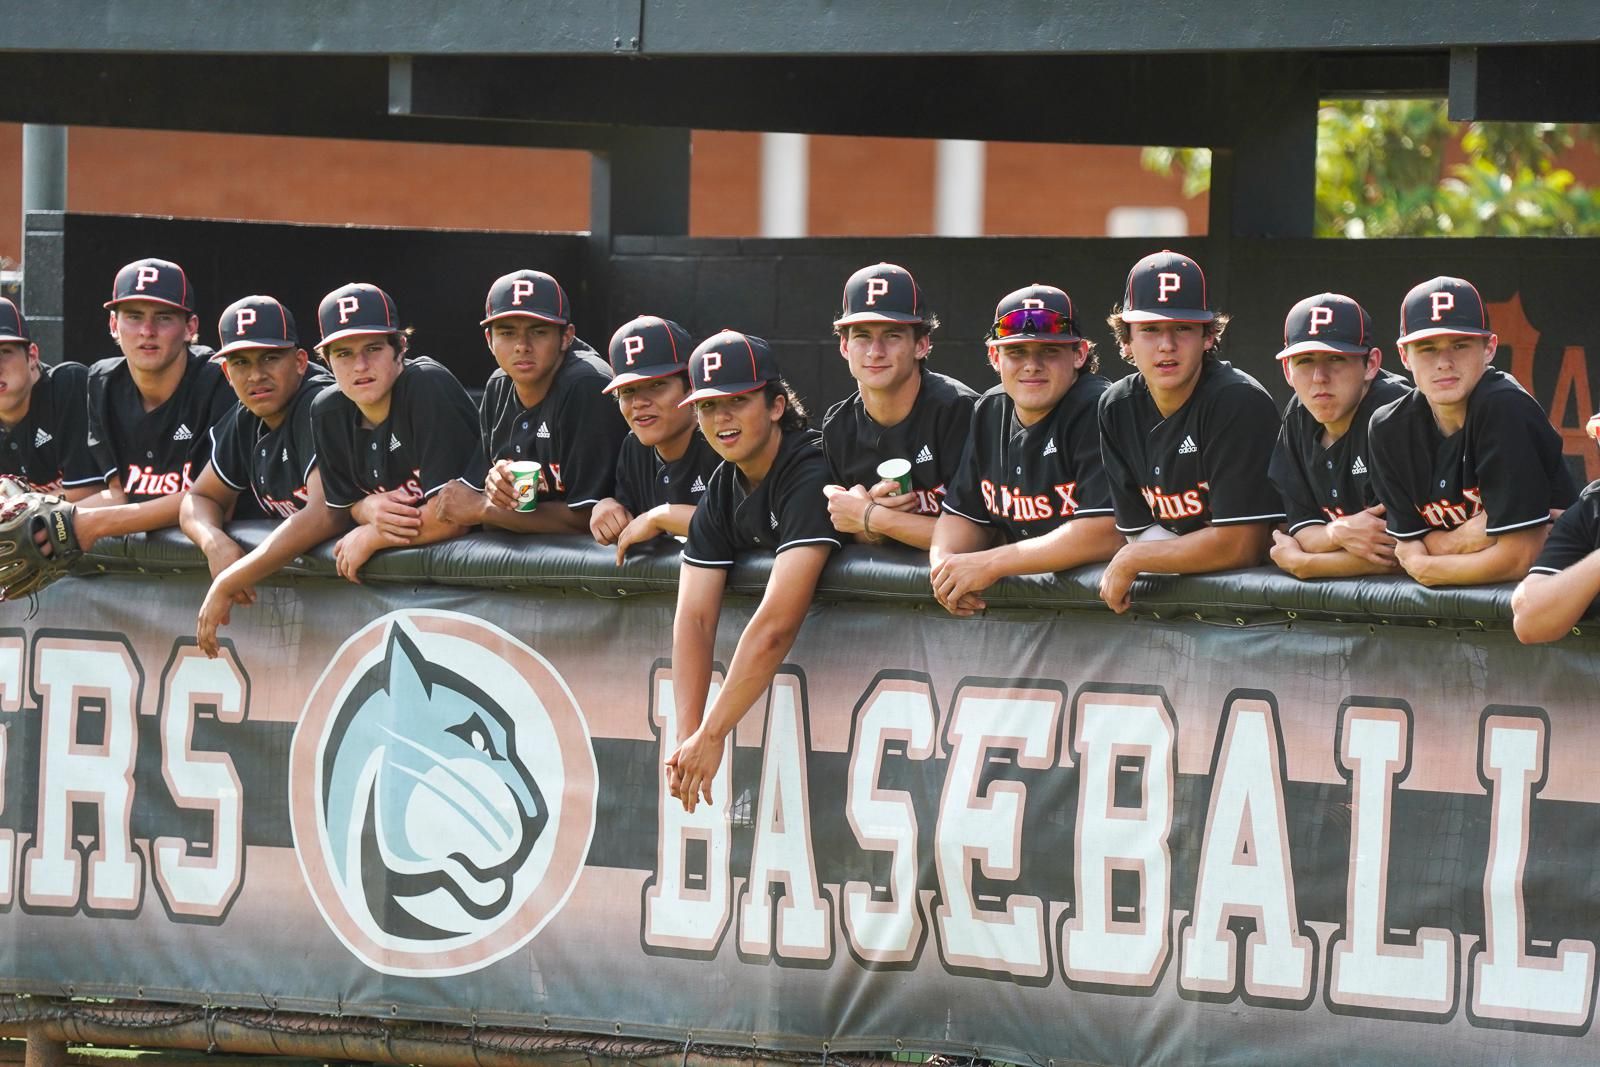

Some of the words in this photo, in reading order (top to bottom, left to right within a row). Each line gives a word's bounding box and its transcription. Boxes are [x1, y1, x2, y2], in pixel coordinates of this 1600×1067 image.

[135, 266, 159, 291] P
[511, 279, 535, 306] P
[865, 278, 888, 305] P
[1157, 272, 1181, 302] P
[336, 296, 359, 324] P
[1308, 306, 1334, 335] P
[1429, 291, 1455, 321] P
[235, 308, 257, 335] P
[622, 335, 644, 365] P
[701, 352, 722, 382] P
[1000, 484, 1055, 522] Pius
[1054, 481, 1079, 517] X
[641, 657, 1597, 1037] BASEBALL
